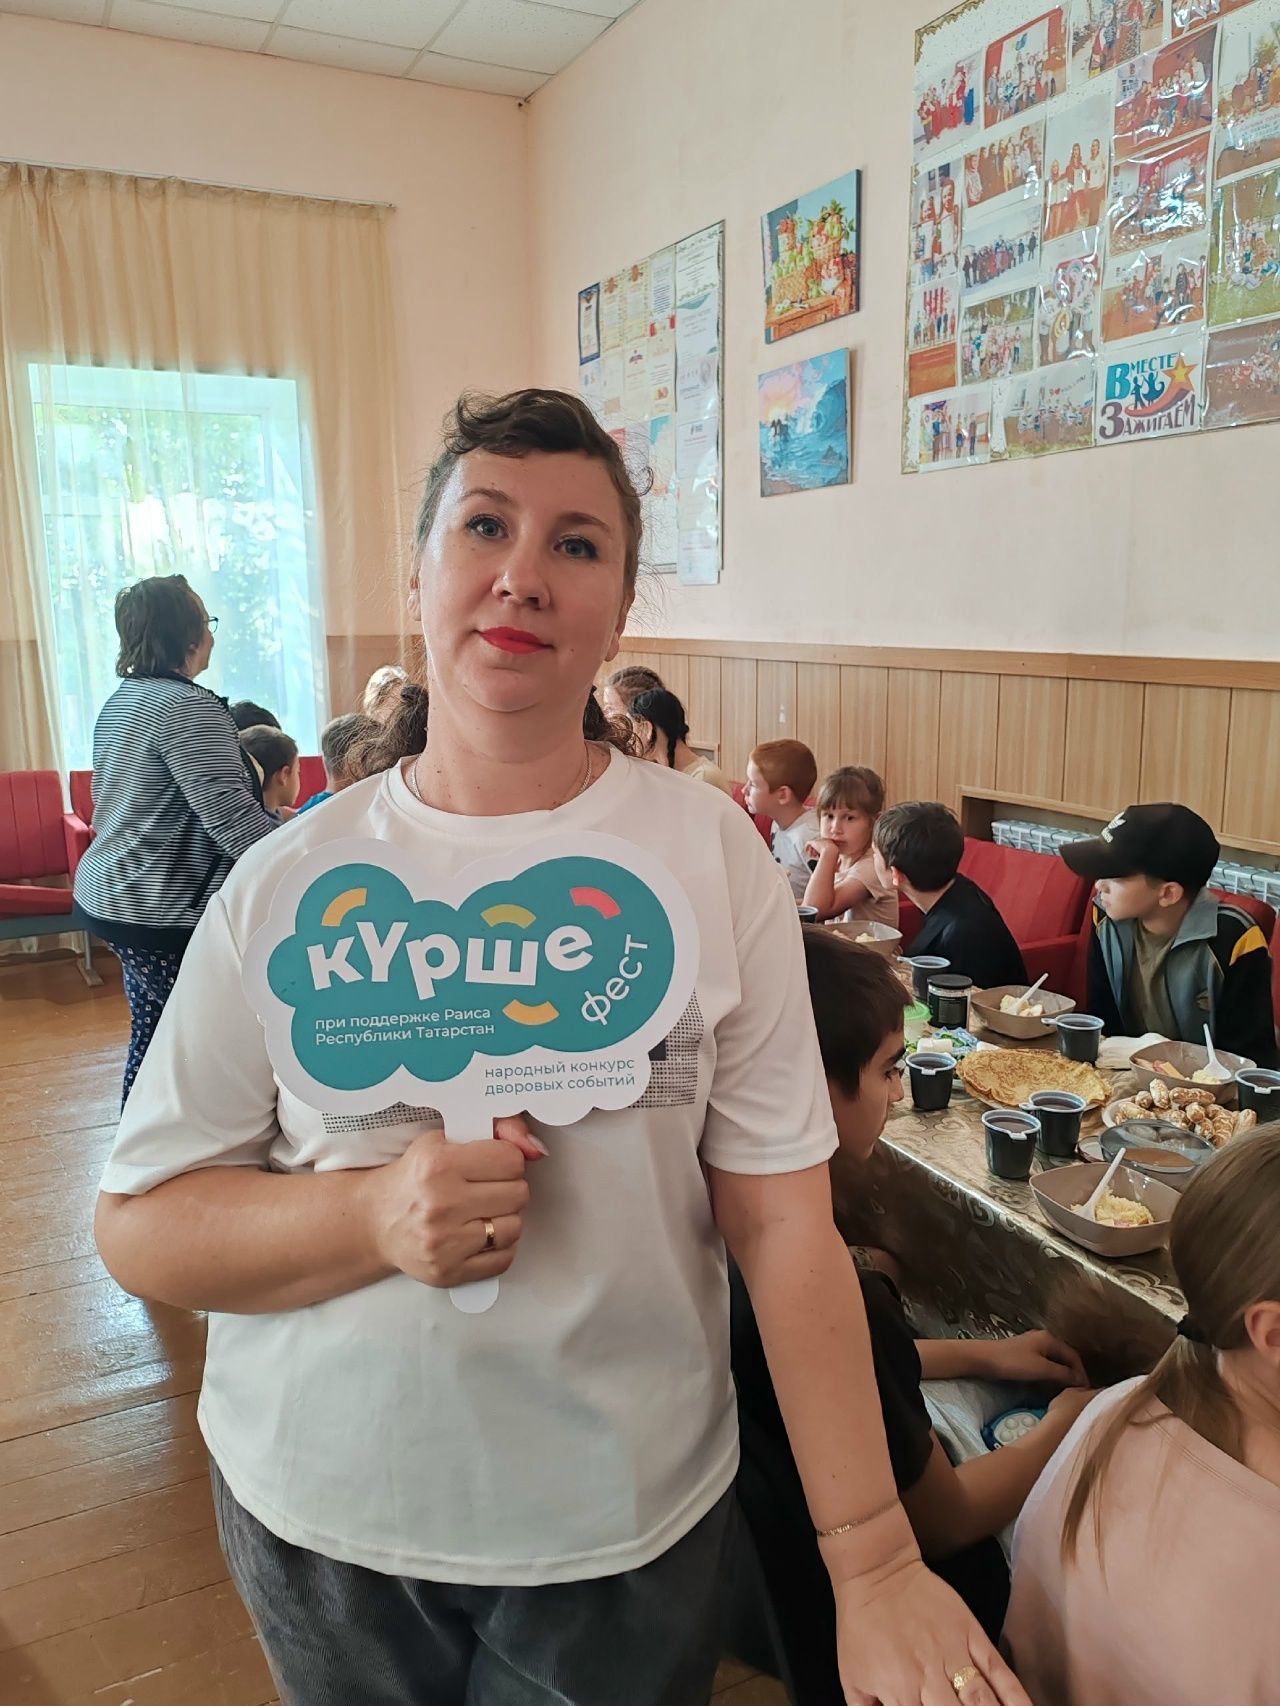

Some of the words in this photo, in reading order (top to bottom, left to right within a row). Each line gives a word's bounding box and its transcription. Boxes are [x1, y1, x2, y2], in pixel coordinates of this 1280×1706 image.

[580, 934, 649, 1026] фест
[315, 1018, 346, 1031] при
[350, 1012, 440, 1027] поддержке
[444, 1008, 491, 1020] Раиса
[315, 1029, 412, 1046] Республики
[415, 1024, 495, 1039] Татарстан
[485, 1062, 566, 1079] народный
[570, 1059, 635, 1074] конкурс
[485, 1080, 564, 1096] дворовых
[567, 1073, 635, 1089] событий
